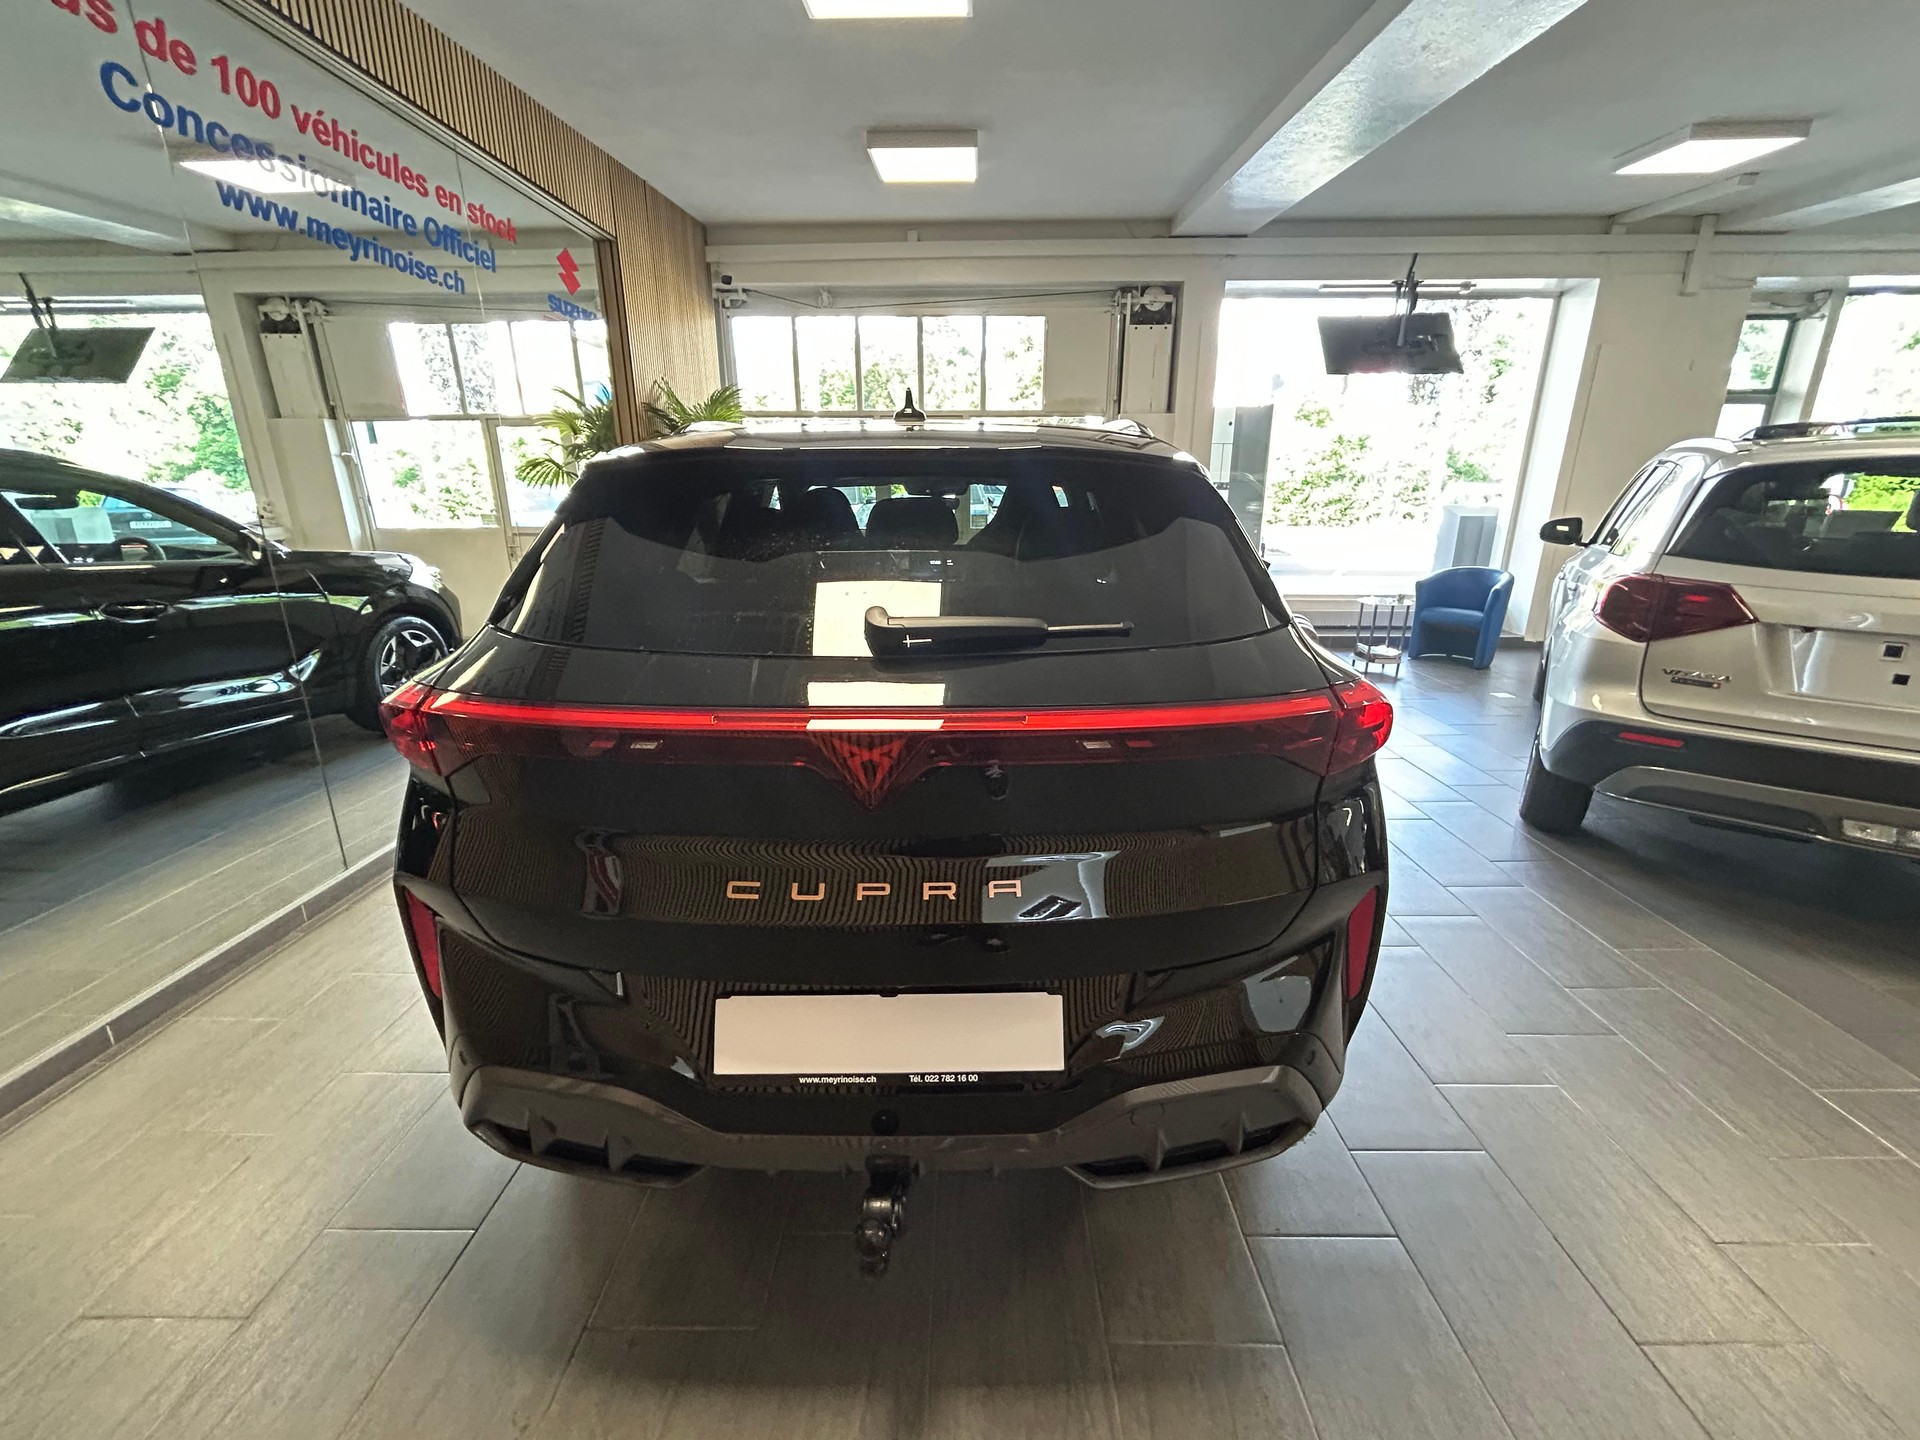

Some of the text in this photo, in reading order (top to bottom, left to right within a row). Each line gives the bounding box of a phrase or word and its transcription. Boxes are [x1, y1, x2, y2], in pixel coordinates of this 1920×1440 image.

[135, 17, 197, 76] de
[210, 55, 281, 119] 100
[291, 104, 429, 197] véhicules
[435, 184, 462, 216] en
[467, 202, 517, 245] stock
[100, 61, 496, 273] Concessionnaire Officiel
[215, 179, 465, 295] www.meyrinoise.ch
[726, 879, 1022, 901] CUPRA
[799, 1075, 877, 1085] www.meyrinoise.ch
[909, 1074, 979, 1083] Tél. 022 782 16 00
